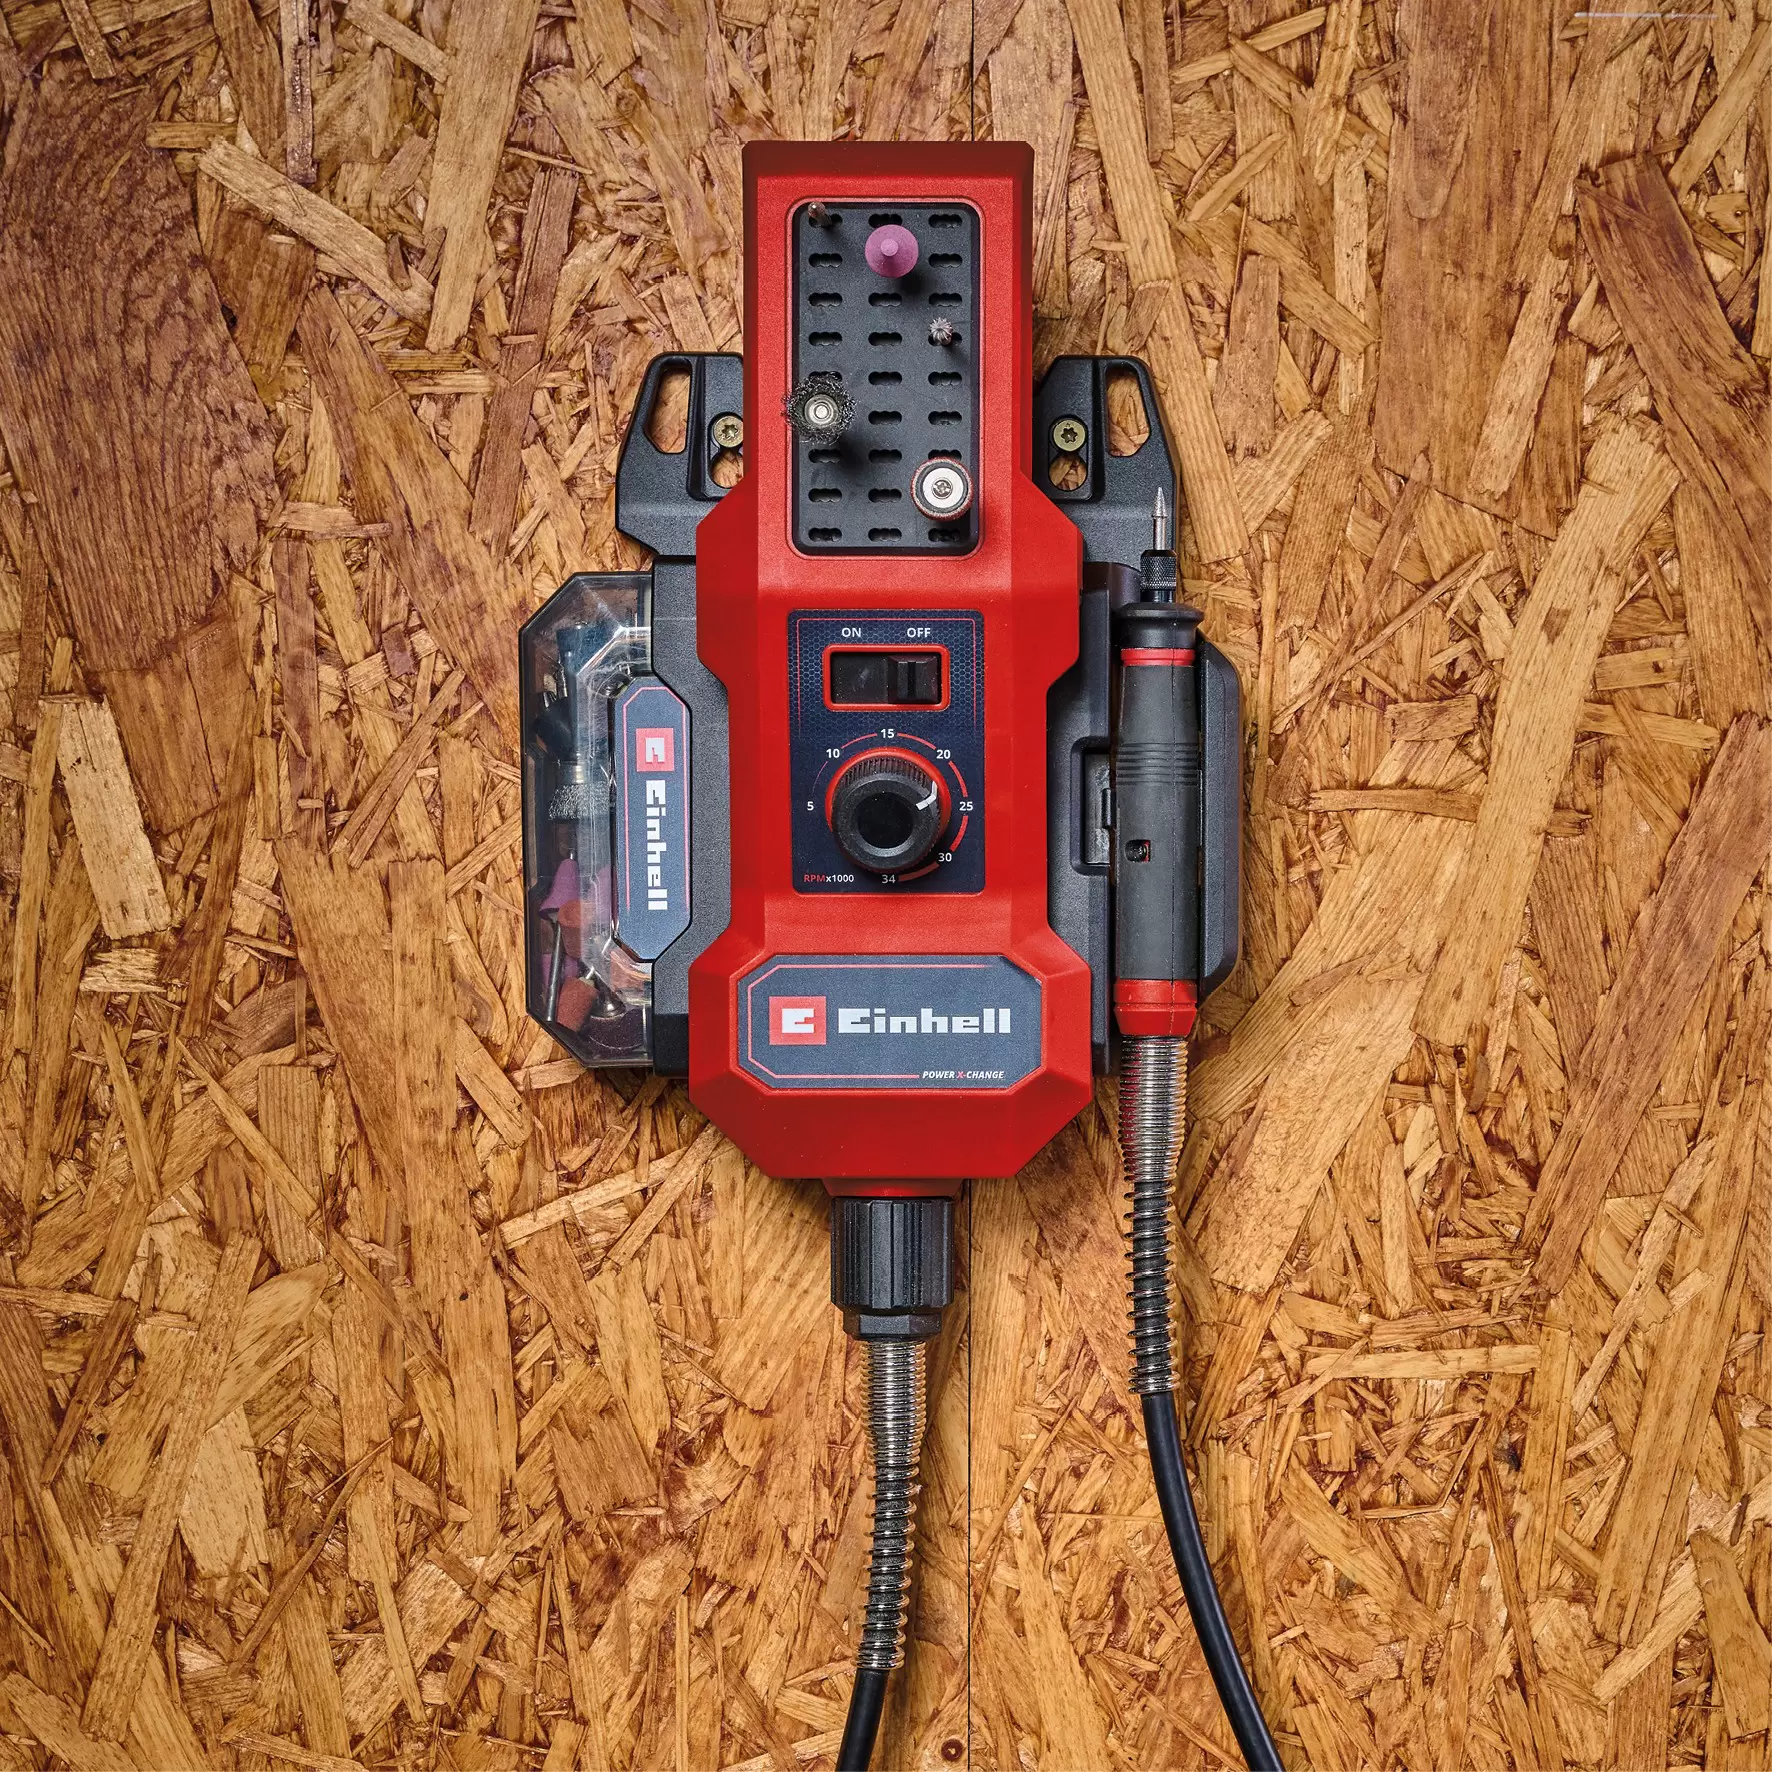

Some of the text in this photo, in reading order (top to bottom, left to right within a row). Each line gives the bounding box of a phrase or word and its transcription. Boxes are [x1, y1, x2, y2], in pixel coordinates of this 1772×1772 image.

[841, 627, 862, 638] ON
[906, 627, 931, 638] OFF
[880, 729, 895, 739] 15
[826, 749, 840, 759] 10
[936, 749, 951, 760] 20
[807, 801, 815, 811] 5
[959, 801, 974, 812] 25
[645, 780, 668, 911] Einhell
[938, 852, 953, 863] 30
[881, 874, 896, 884] 34
[838, 1008, 1011, 1033] Einhell
[922, 1070, 955, 1079] POWER
